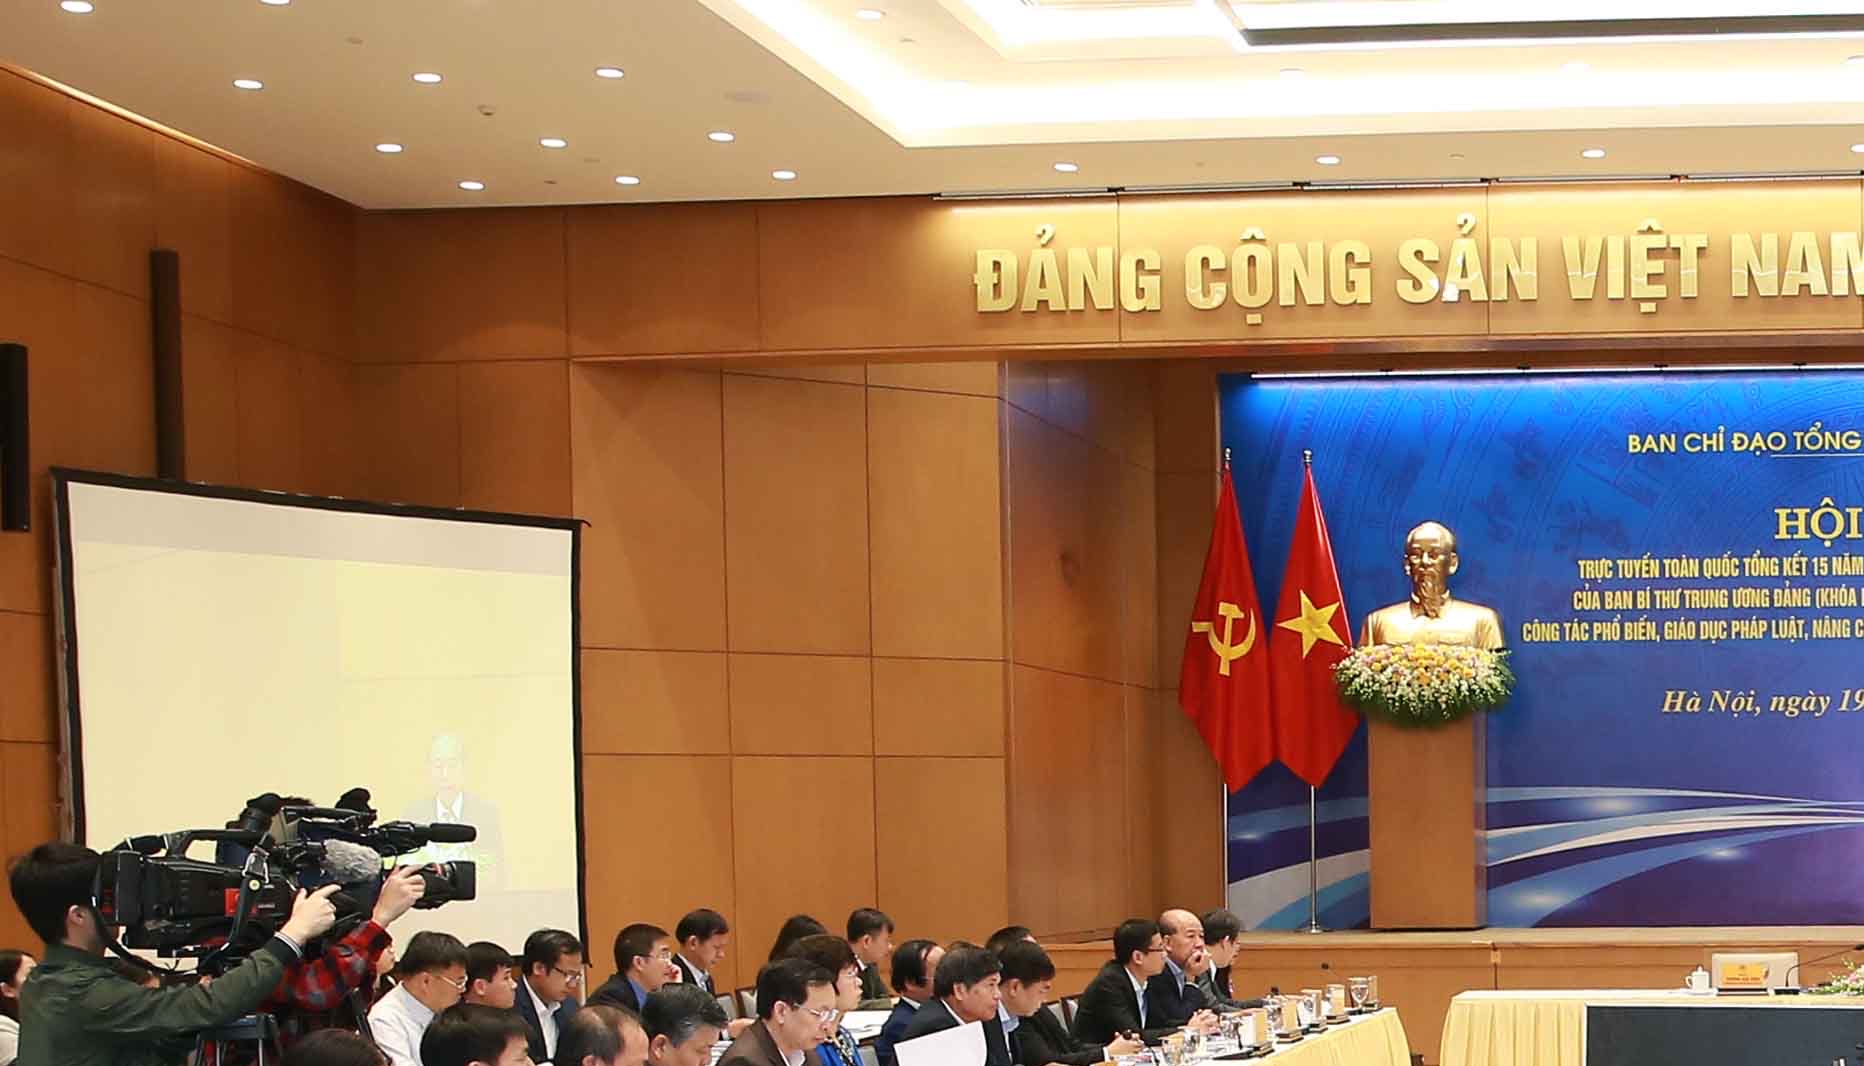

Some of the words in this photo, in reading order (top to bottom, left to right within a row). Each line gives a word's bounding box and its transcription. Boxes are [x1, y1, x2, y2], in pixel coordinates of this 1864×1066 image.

[974, 224, 1161, 312] ĐẢNG
[1185, 227, 1372, 325] CỘNG
[1396, 213, 1538, 304] SẢN
[1562, 218, 1709, 313] VIỆT
[1628, 433, 1676, 453] BAN
[1683, 425, 1725, 453] CHỈ
[1731, 432, 1787, 456] ĐẠO
[1793, 421, 1862, 450] TỔNG
[1775, 497, 1863, 547] HỘI
[1578, 559, 1614, 583] TRỰC
[1616, 551, 1660, 578] TUYẾN
[1662, 553, 1700, 578] TOÀN
[1702, 550, 1740, 577] QUỐC
[1742, 550, 1780, 577] TỔNG
[1782, 549, 1808, 577] KẾT
[1812, 557, 1828, 577] 15
[1832, 552, 1864, 576] NĂM
[1574, 582, 1602, 610] CỦA
[1604, 590, 1632, 610] BAN
[1636, 585, 1650, 609] BÍ
[1654, 589, 1682, 609] THƯ
[1684, 589, 1728, 609] TRUNG
[1732, 589, 1770, 609] ƯƠNG
[1772, 580, 1812, 608] ĐẢNG
[1816, 583, 1858, 608] (KHÓA
[1522, 616, 1560, 641] CÔNG
[1562, 616, 1590, 641] TÁC
[1592, 613, 1620, 641] PHỔ
[1624, 613, 1660, 643] BIẾN,
[1664, 615, 1696, 640] GIÁO
[1700, 620, 1728, 645] DỤC
[1730, 615, 1768, 640] PHÁP
[1772, 615, 1808, 645] LUẬT,
[1812, 614, 1850, 639] NÂNG
[1662, 690, 1701, 713] Hà
[1708, 688, 1761, 718] Nội,
[1769, 690, 1831, 718] ngày
